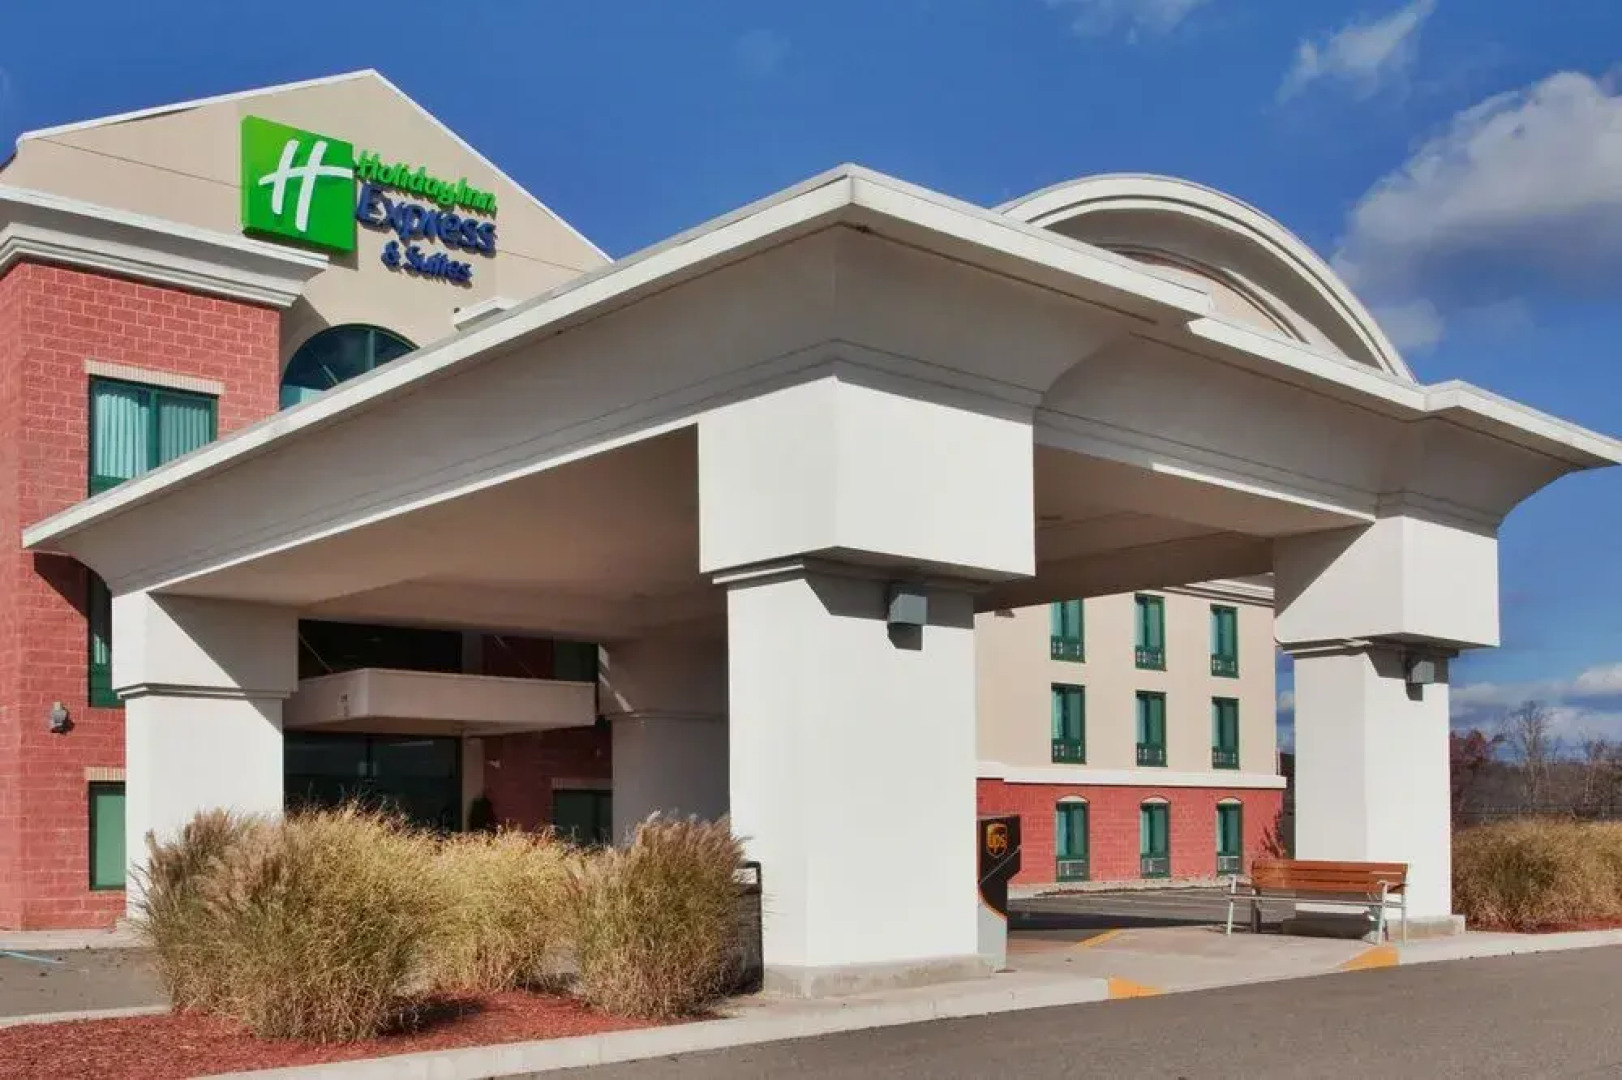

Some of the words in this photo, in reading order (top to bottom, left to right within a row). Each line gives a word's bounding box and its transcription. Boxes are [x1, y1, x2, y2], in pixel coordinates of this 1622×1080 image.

[358, 151, 456, 206] Holiday
[456, 177, 497, 213] Inn
[357, 182, 497, 252] Express
[381, 240, 400, 268] &
[405, 246, 473, 284] Suites
